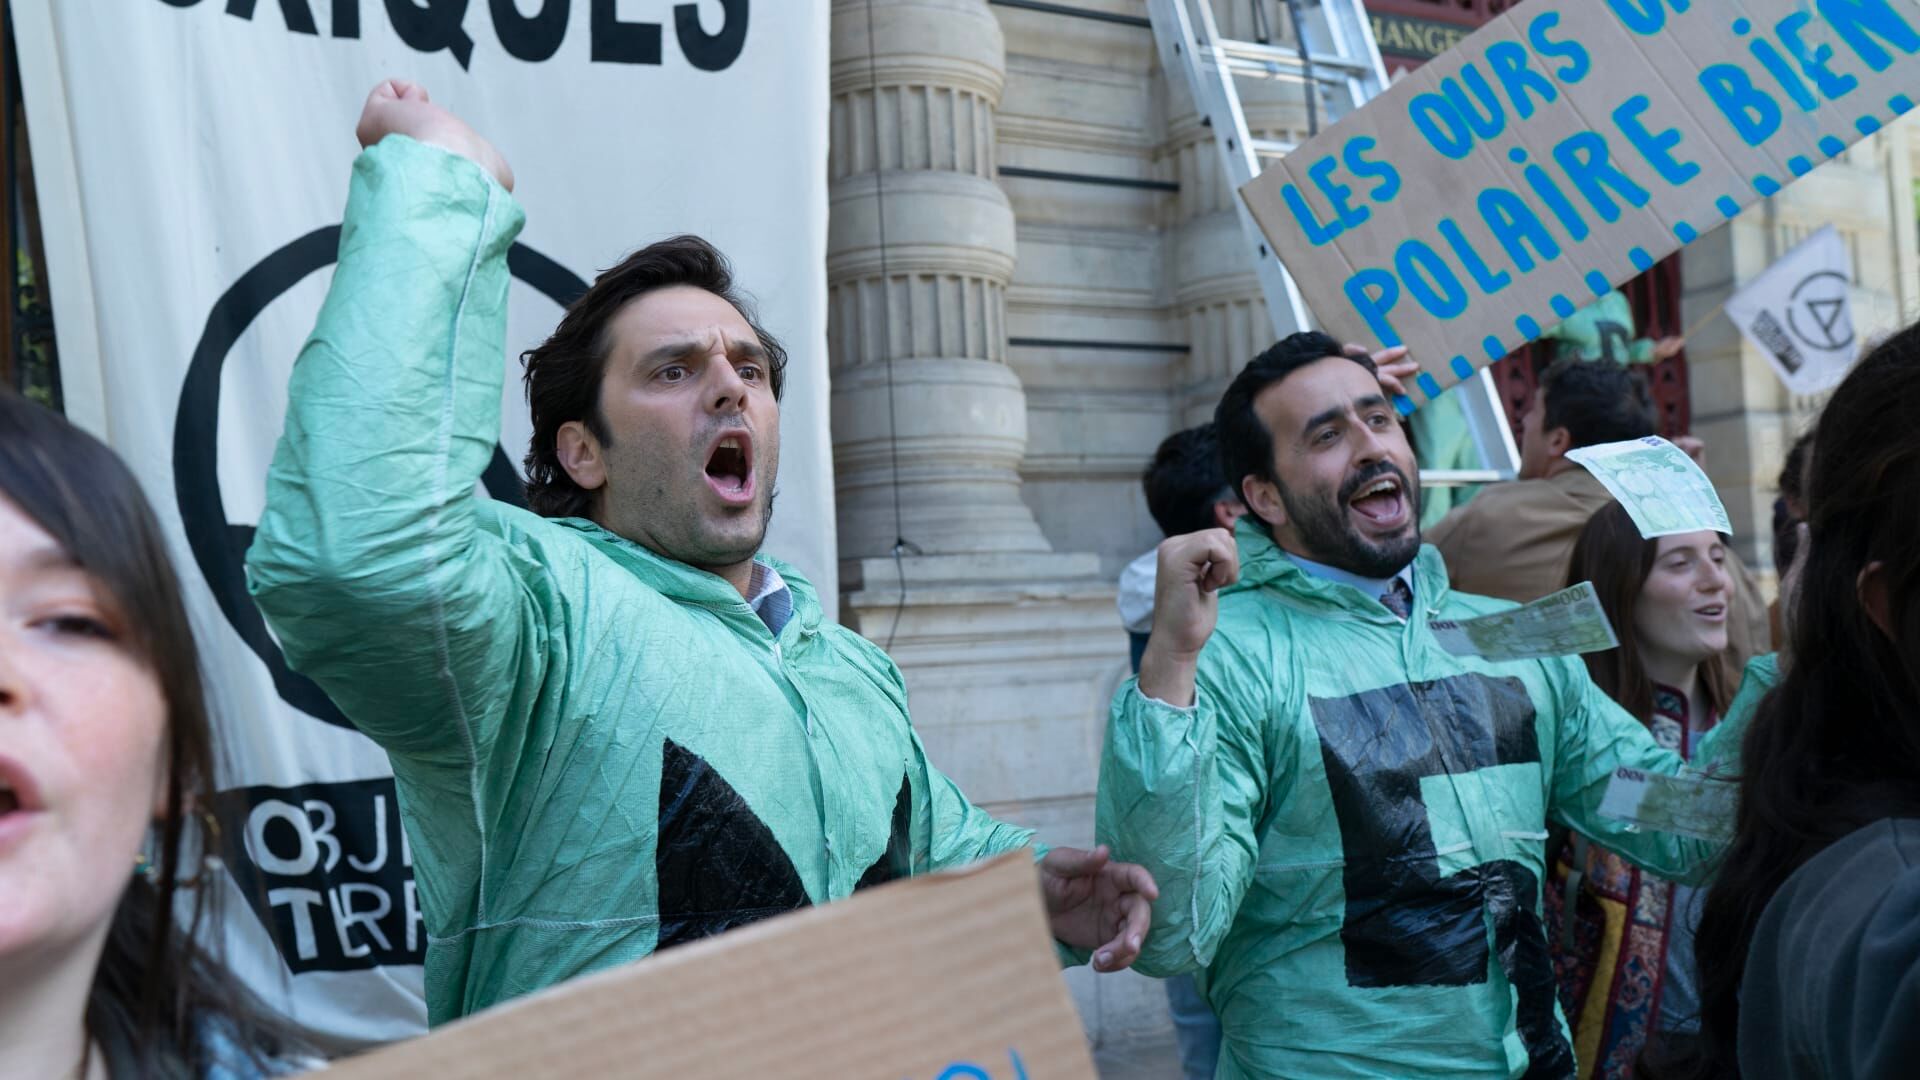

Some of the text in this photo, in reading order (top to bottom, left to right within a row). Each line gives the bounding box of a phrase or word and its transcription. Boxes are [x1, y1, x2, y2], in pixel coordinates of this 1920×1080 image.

[1281, 11, 1591, 247] LES OURS
[243, 795, 412, 875] OBJ
